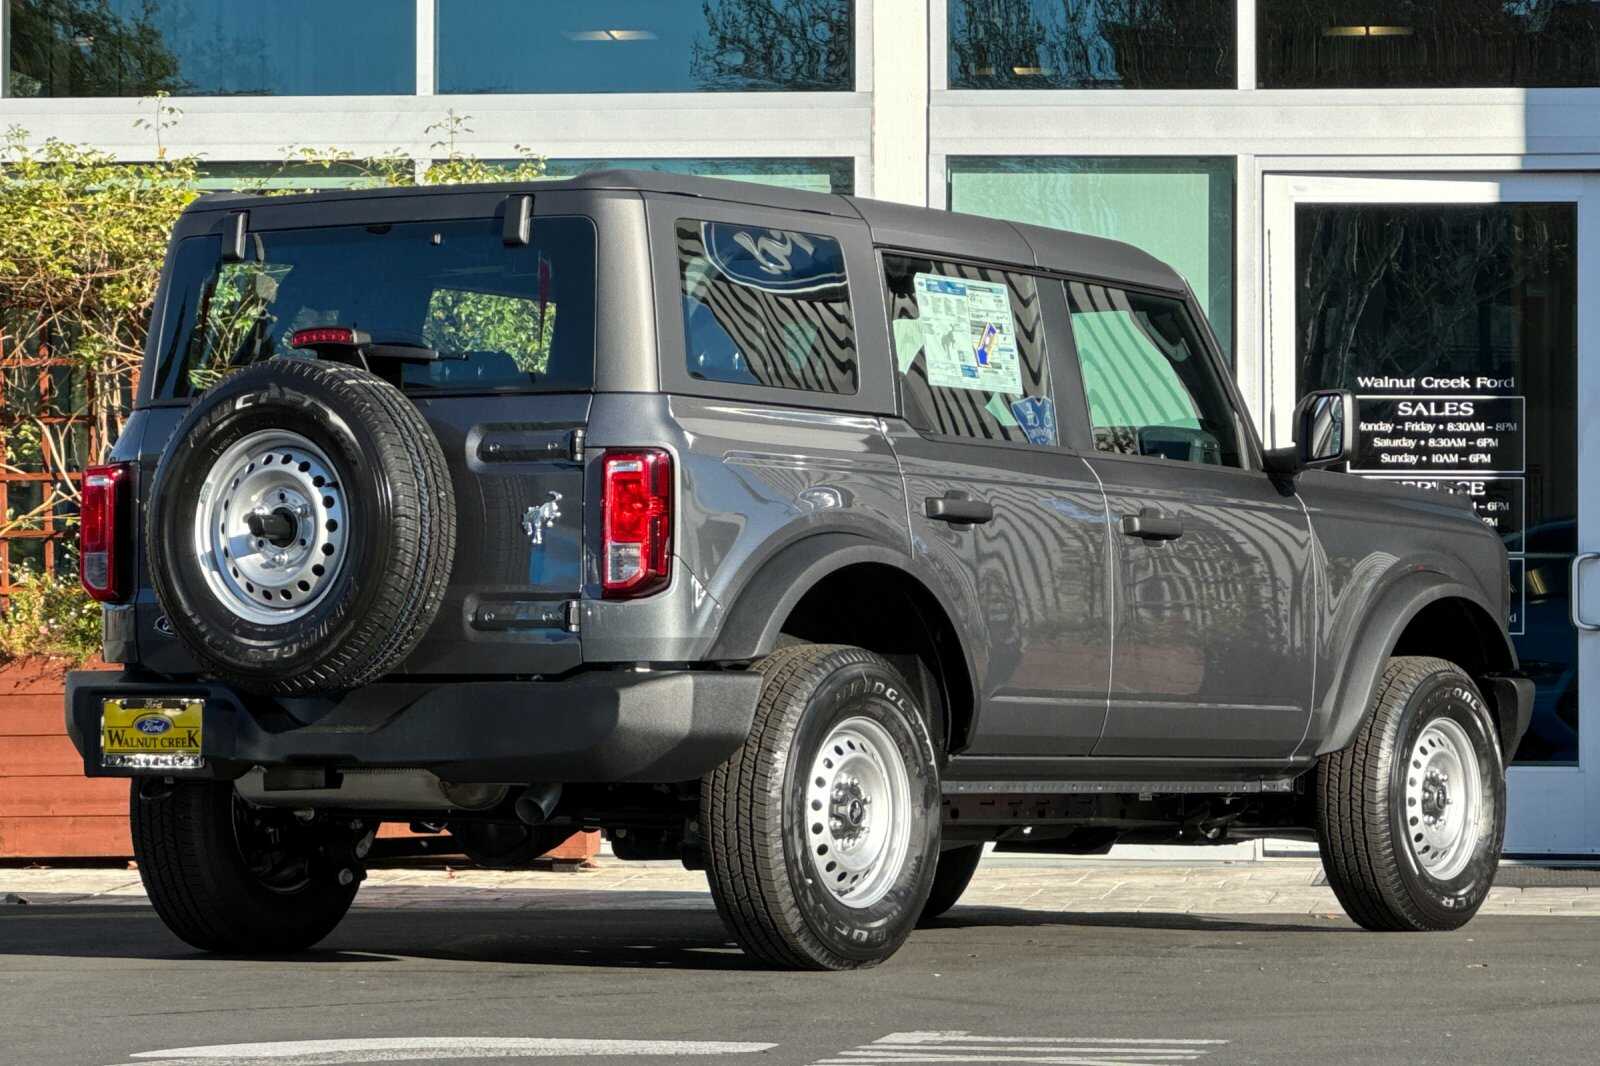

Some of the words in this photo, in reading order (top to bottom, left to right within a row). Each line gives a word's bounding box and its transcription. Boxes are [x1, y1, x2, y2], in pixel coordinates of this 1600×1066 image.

[1357, 376, 1416, 388] Walnut
[1421, 376, 1471, 388] Creek
[1476, 377, 1515, 389] Ford
[1398, 401, 1474, 416] SALES
[1404, 421, 1437, 433] Friday
[1447, 422, 1485, 432] 8:30AM
[1495, 422, 1518, 432] 8PM
[1373, 437, 1417, 449] Saturday
[1476, 438, 1499, 448] 6PM
[1380, 453, 1419, 465] Sunday
[1432, 453, 1459, 463] 10AM
[1468, 453, 1492, 463] 6PM
[142, 719, 165, 732] Ford
